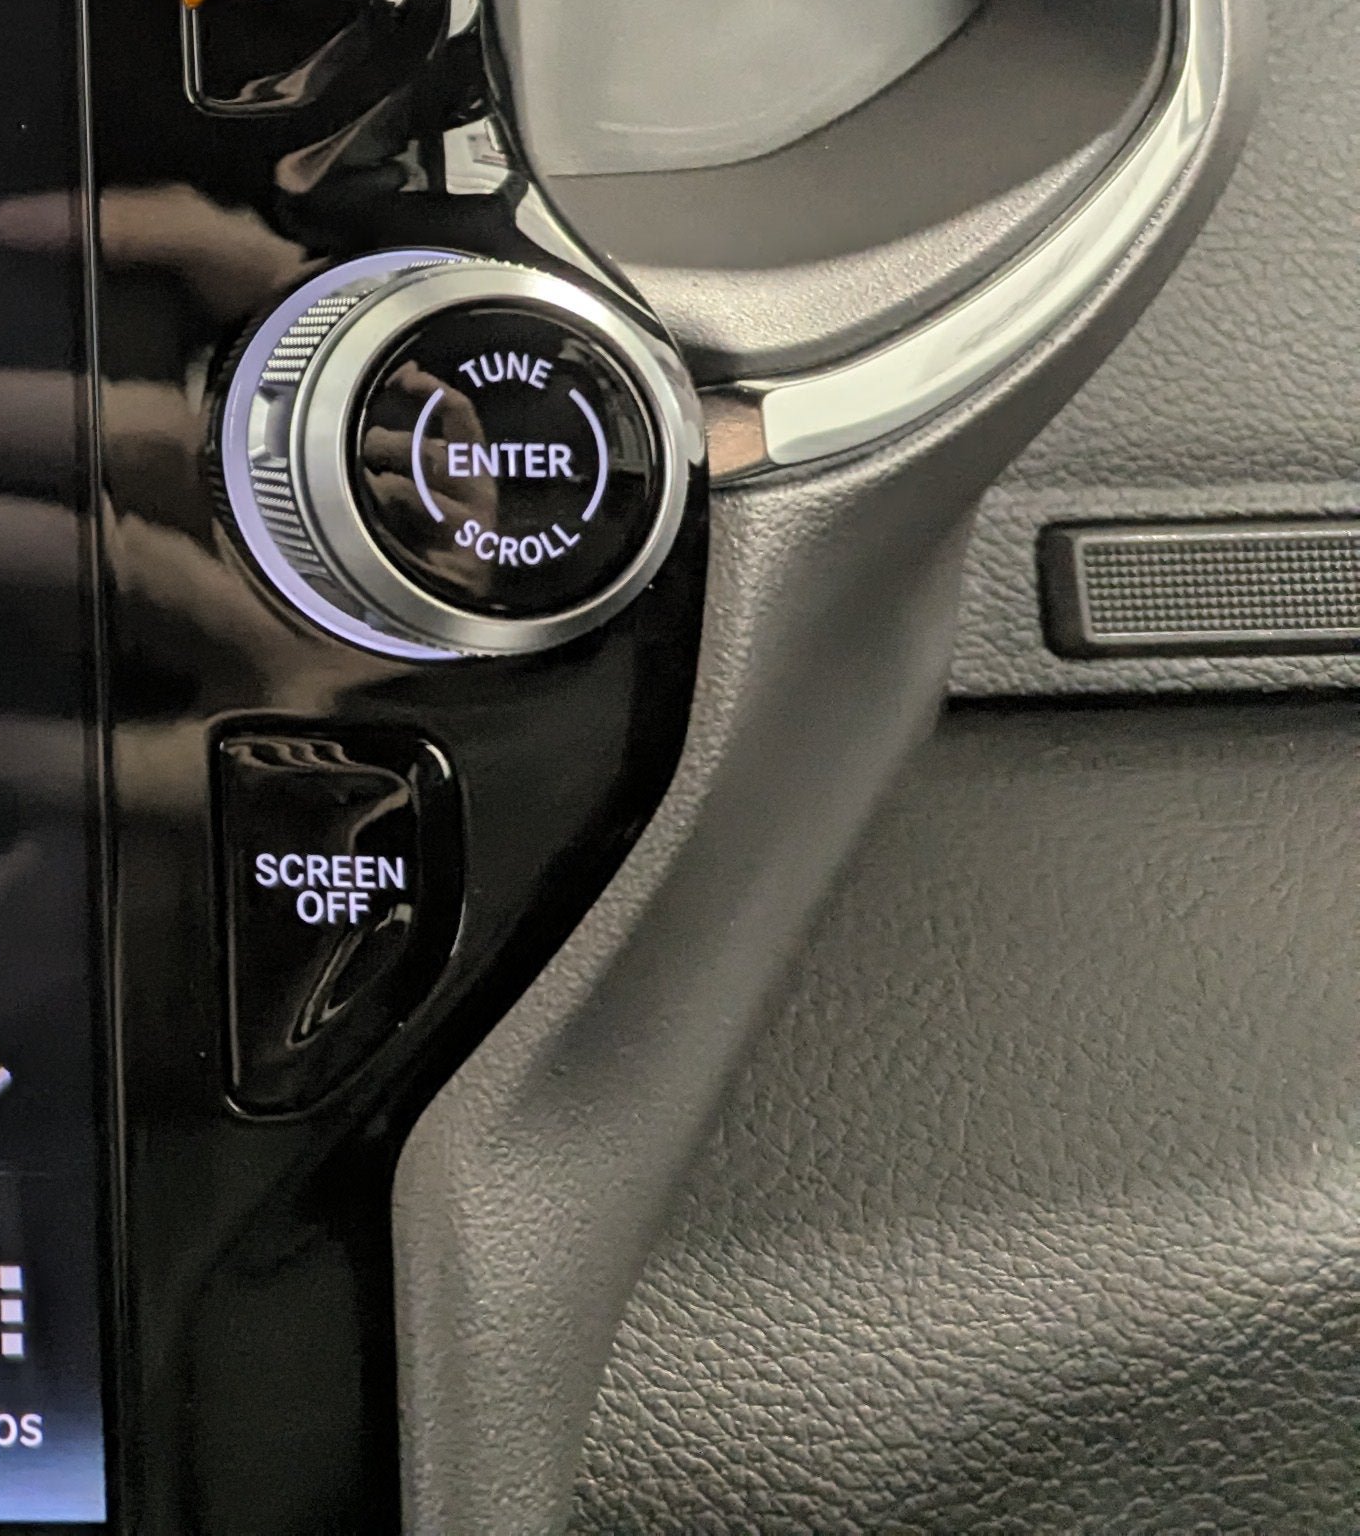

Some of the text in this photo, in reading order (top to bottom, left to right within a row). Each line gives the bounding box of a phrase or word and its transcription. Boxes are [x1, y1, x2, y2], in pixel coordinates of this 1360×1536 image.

[458, 351, 553, 389] TUNE
[447, 442, 573, 478] ENTER
[454, 519, 580, 566] SCROLL
[255, 852, 404, 889] SCREEN
[296, 890, 369, 924] OFF
